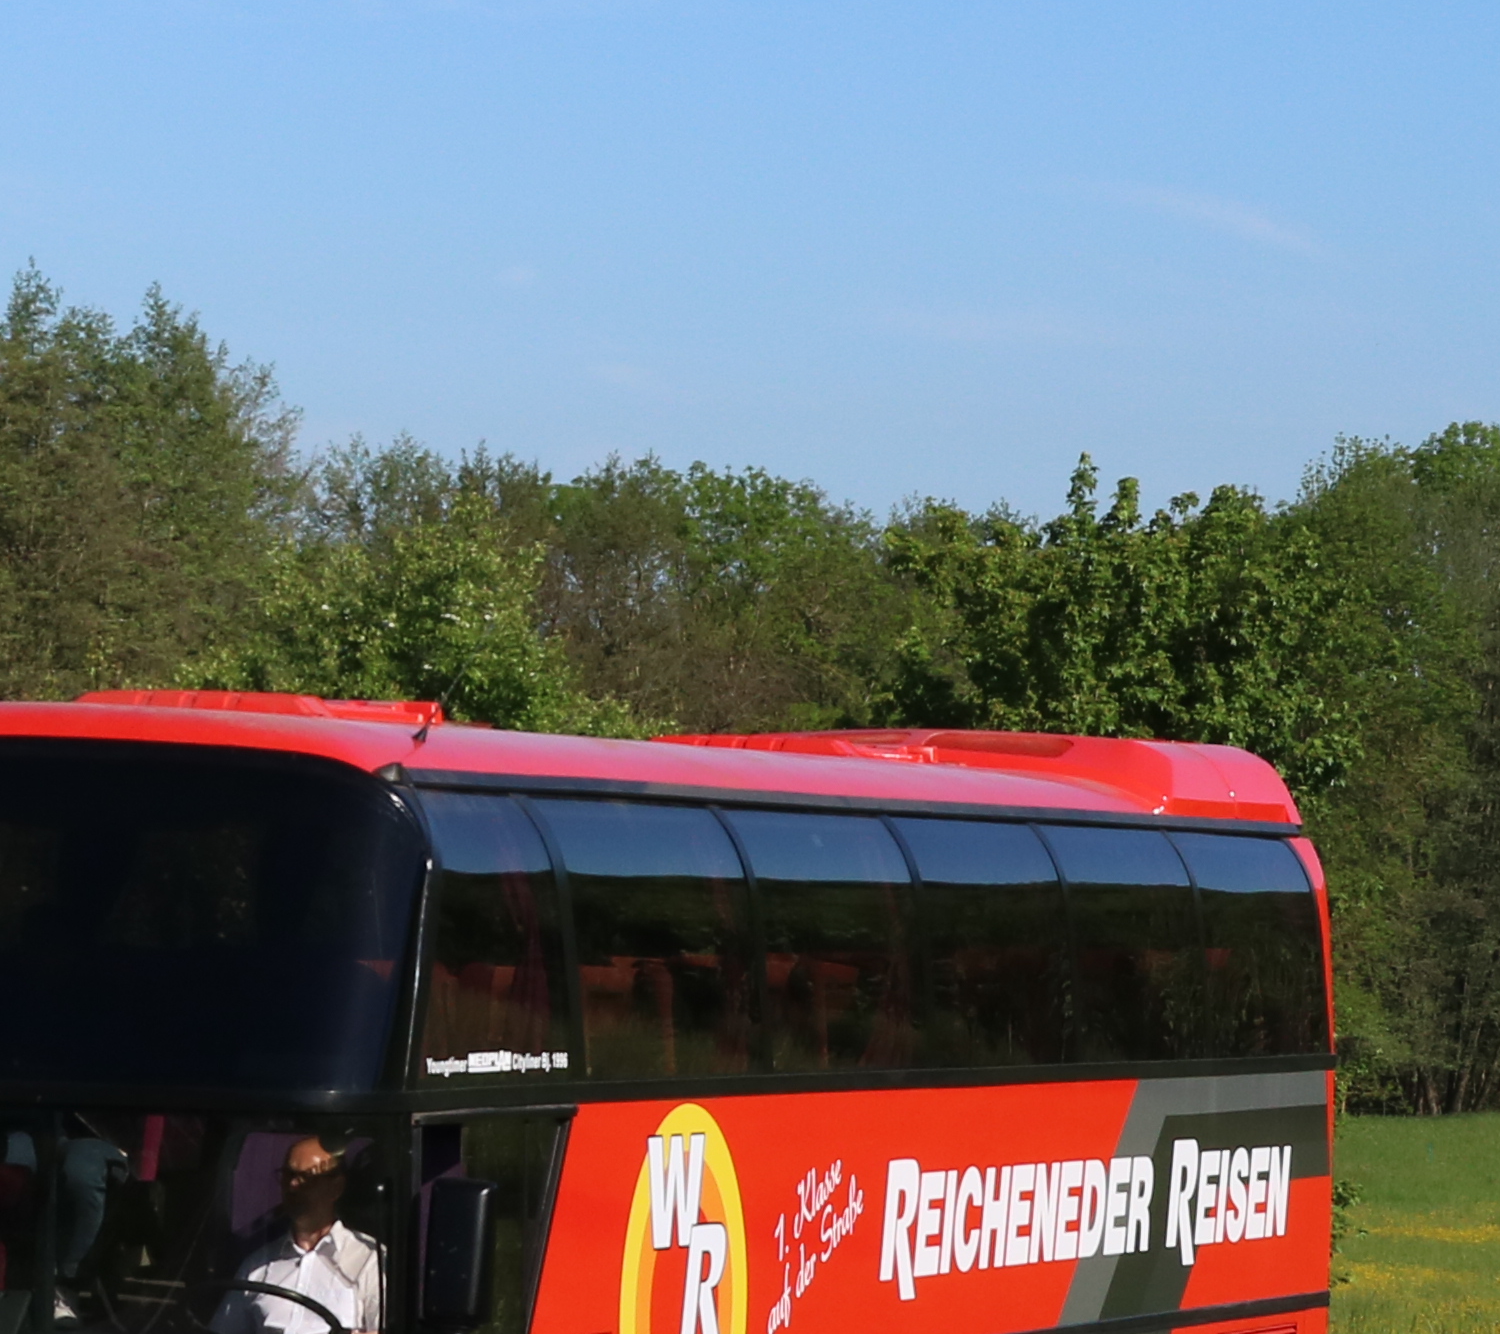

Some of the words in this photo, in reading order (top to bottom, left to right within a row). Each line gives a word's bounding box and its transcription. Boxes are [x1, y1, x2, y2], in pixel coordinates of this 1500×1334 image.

[468, 1050, 512, 1073] NEOPLAN
[513, 1053, 541, 1074] Cityliner
[774, 1213, 790, 1261] 1.
[794, 1159, 842, 1239] Klasse
[795, 1243, 816, 1298] der
[821, 1174, 863, 1262] Straße
[879, 1157, 1154, 1301] REICHENEDER
[1165, 1138, 1292, 1266] REISEN
